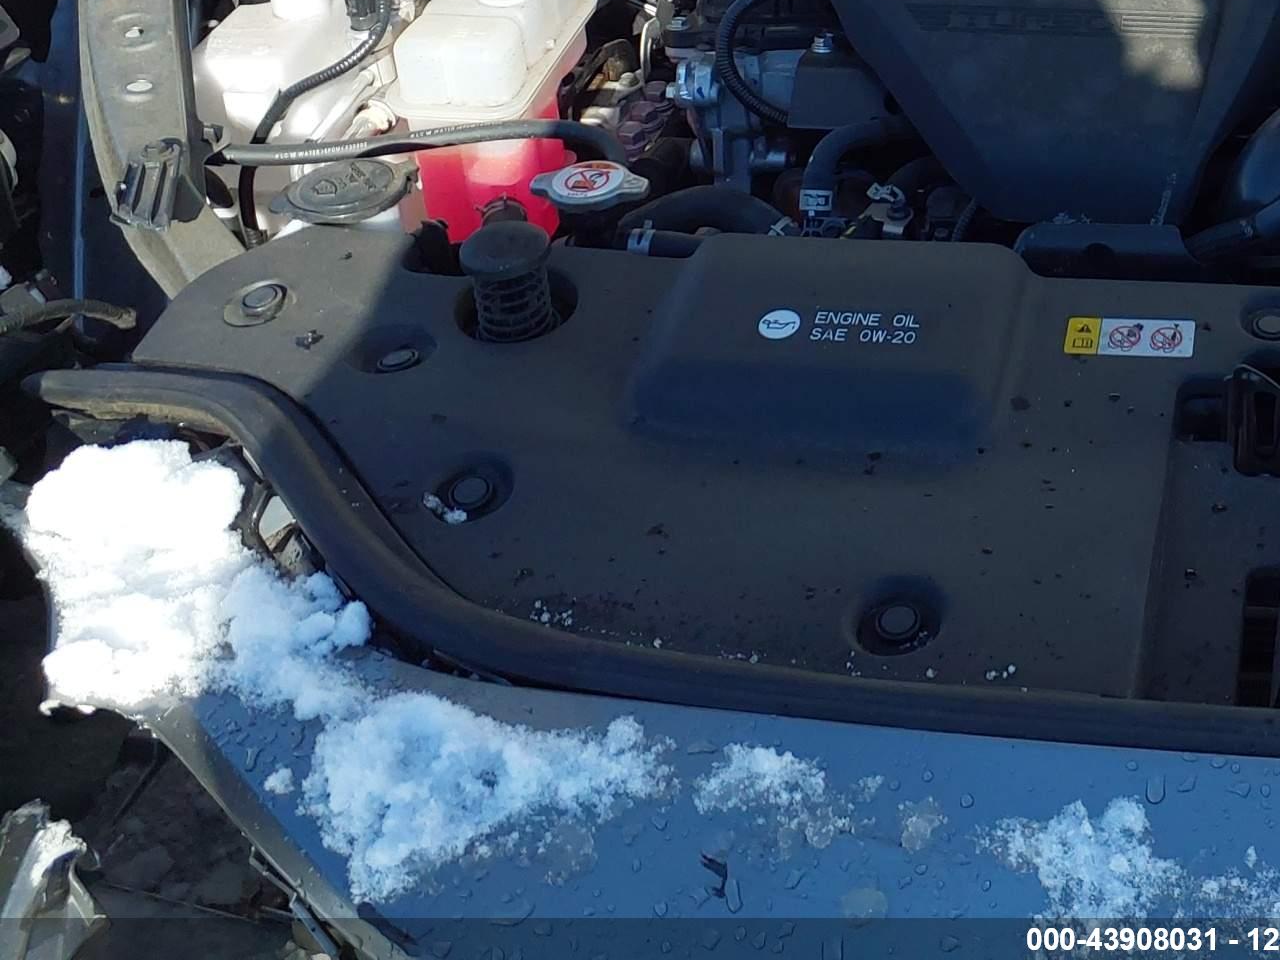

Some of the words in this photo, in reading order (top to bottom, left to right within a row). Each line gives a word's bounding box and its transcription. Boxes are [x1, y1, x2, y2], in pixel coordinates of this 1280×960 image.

[814, 311, 882, 326] ENGINE
[893, 314, 920, 328] OIL
[809, 327, 847, 342] SAE
[859, 329, 916, 344] 0W-20
